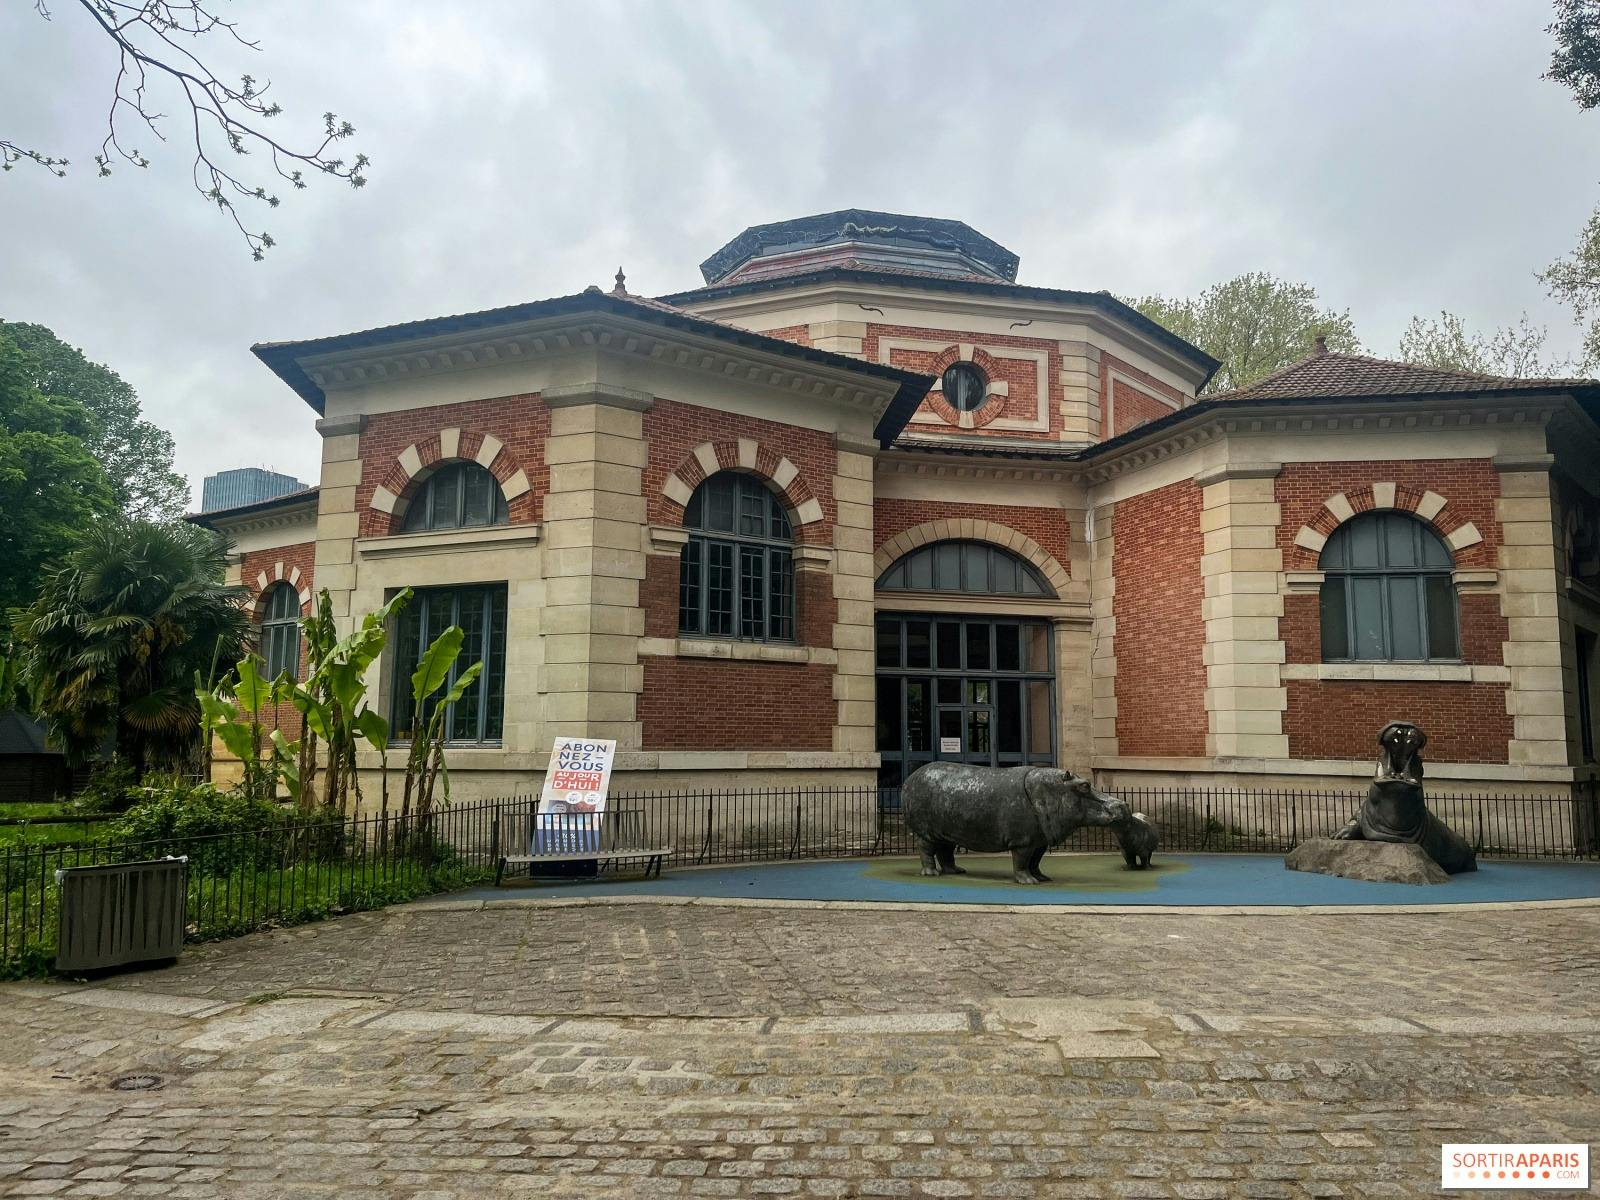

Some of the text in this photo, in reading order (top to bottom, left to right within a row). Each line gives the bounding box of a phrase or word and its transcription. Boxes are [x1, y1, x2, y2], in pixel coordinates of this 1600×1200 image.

[561, 743, 607, 753] ABON
[558, 760, 604, 771] VOUS
[556, 772, 600, 782] AUJOUR
